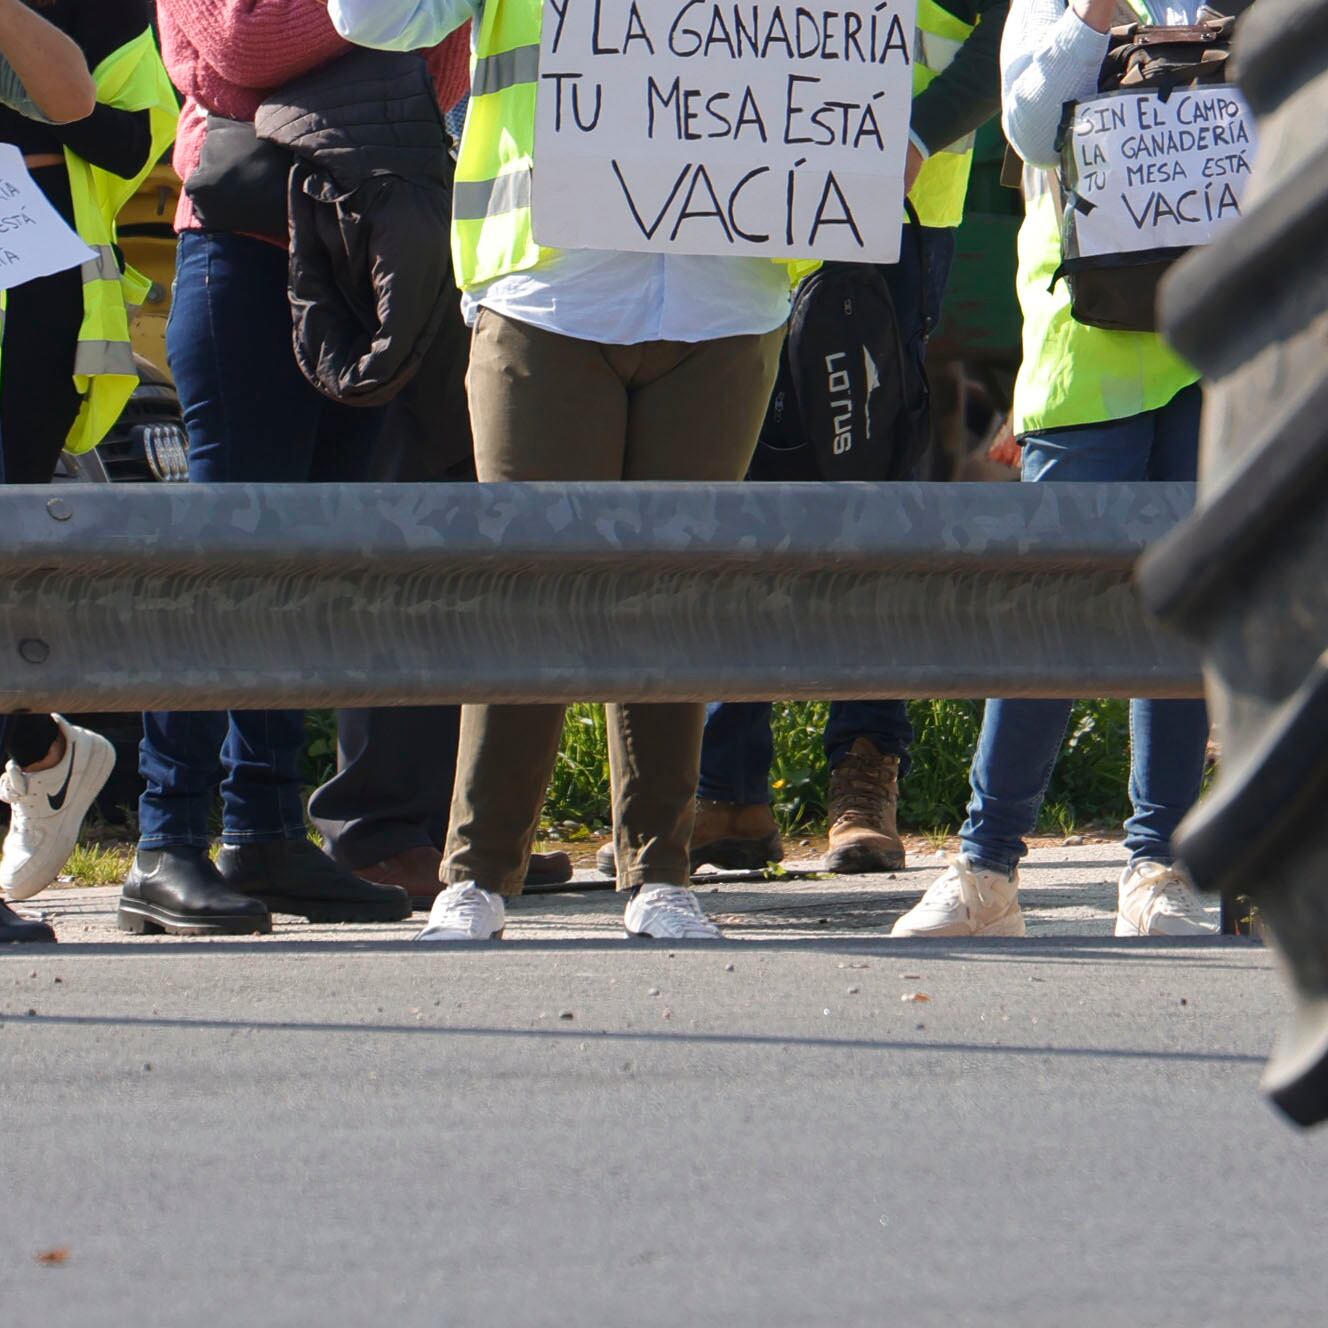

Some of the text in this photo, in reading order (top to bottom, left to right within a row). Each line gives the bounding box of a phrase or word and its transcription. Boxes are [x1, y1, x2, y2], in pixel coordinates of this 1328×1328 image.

[541, 73, 885, 151] TU MESA ESTÁ
[1077, 96, 1239, 137] SIN EL CAMPO
[1082, 120, 1250, 167] LA GANADERÍA
[1083, 149, 1252, 192] TU MESA ESTÁ
[611, 158, 864, 247] VACÍA
[1121, 182, 1243, 230] VACÍA
